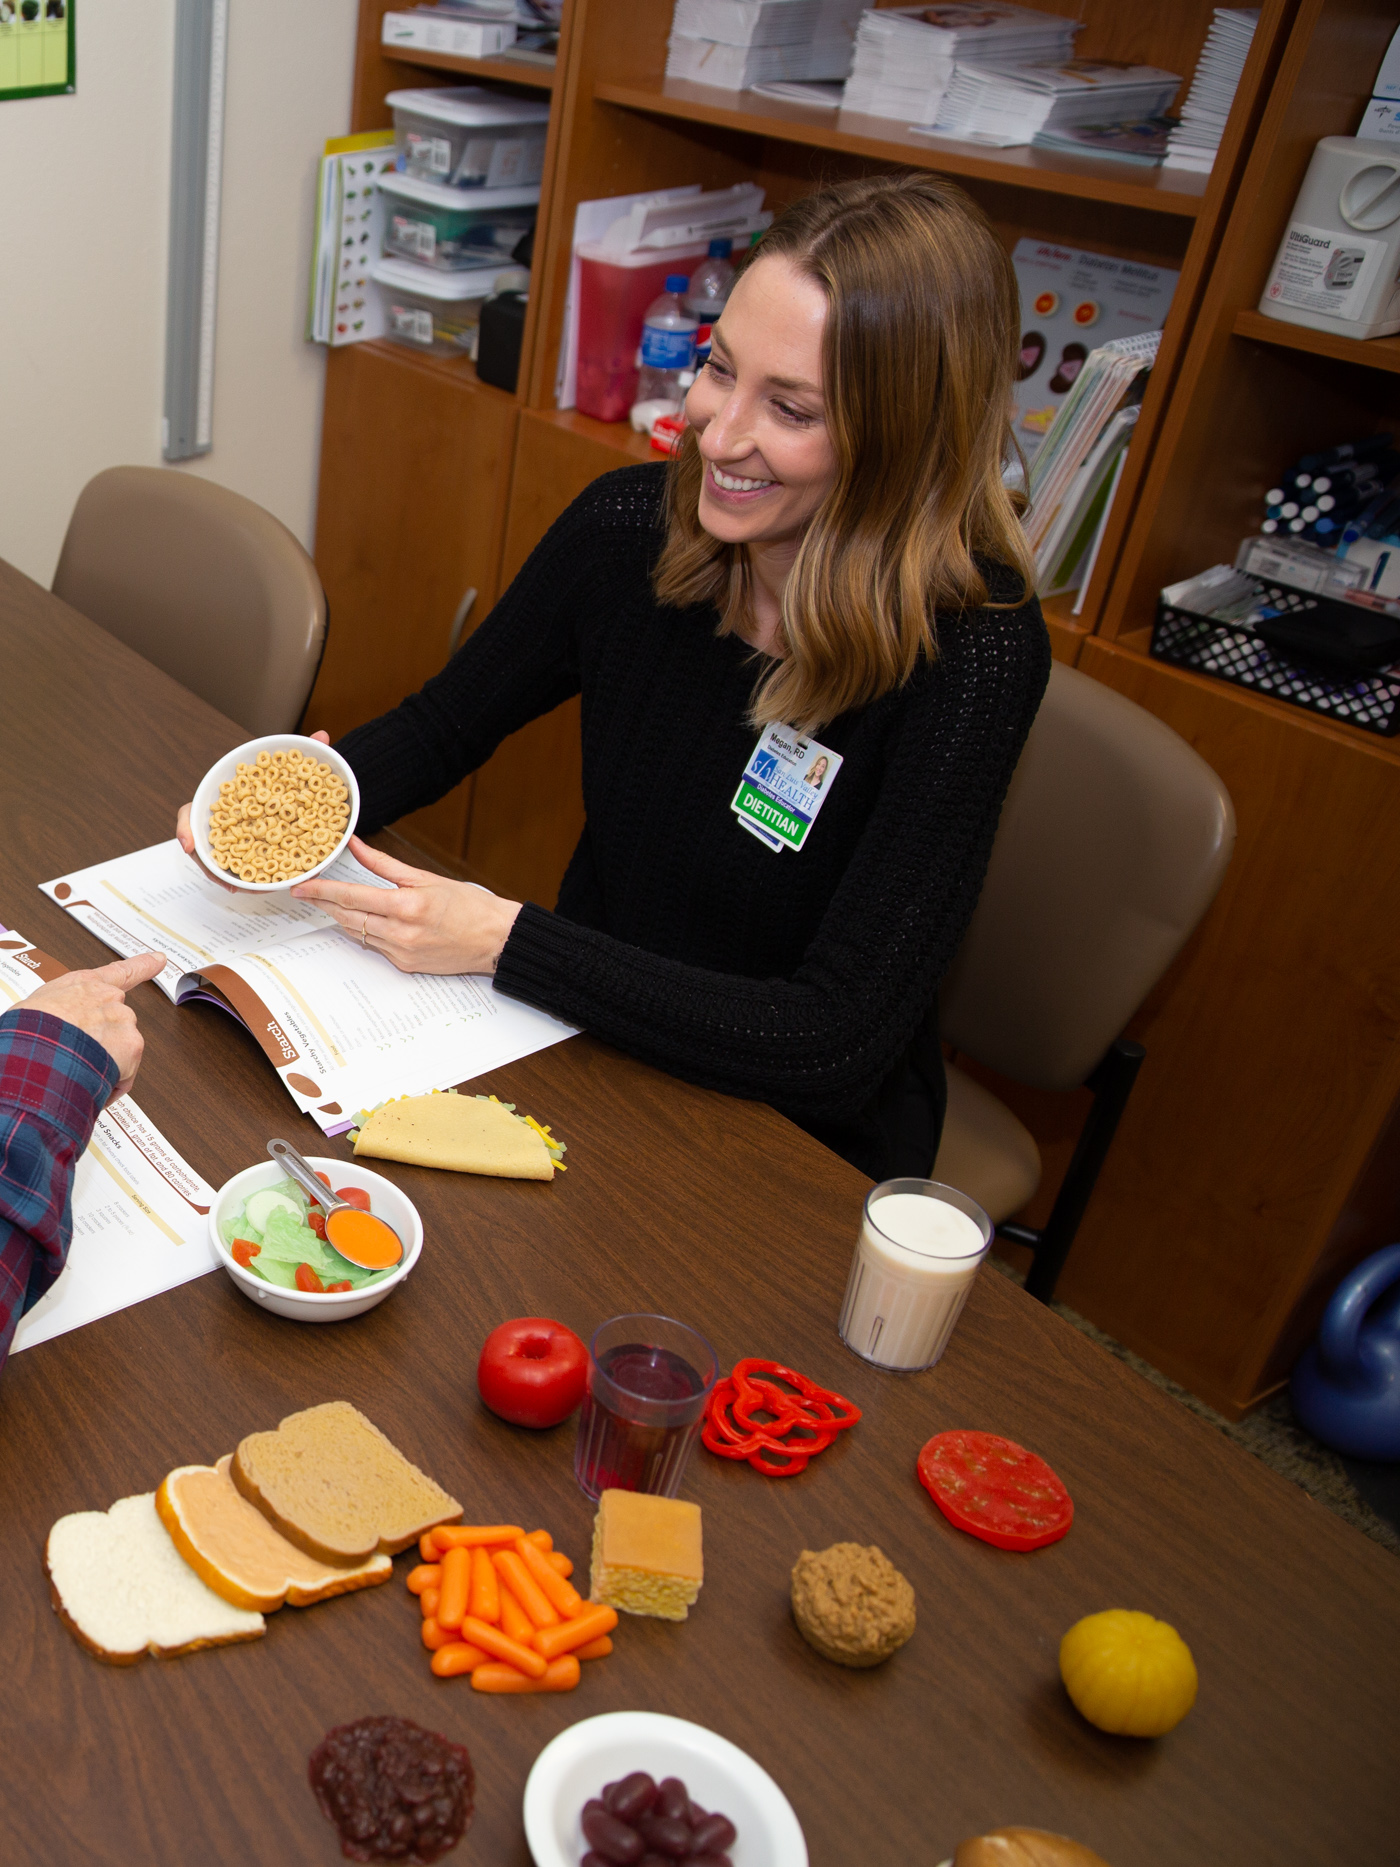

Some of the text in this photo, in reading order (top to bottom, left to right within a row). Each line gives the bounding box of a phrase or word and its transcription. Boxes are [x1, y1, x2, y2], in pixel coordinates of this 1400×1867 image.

[770, 733, 805, 759] Megan, RD
[756, 783, 796, 813] Diabetes Educator
[769, 772, 814, 811] HEALTH
[786, 774, 798, 785] Luis
[800, 781, 818, 799] Valley
[743, 792, 799, 837] DIETITIAN
[16, 951, 41, 970] Starch
[266, 1020, 295, 1060] Starch
[282, 1011, 327, 1074] Starchy Vegetables
[103, 1127, 121, 1149] Snacks
[123, 1107, 138, 1124] choice
[136, 1123, 146, 1133] has
[145, 1133, 153, 1141] 15
[149, 1141, 166, 1156] grams
[131, 1133, 145, 1147] gram
[156, 1161, 167, 1172] and
[165, 1170, 174, 1178] 80
